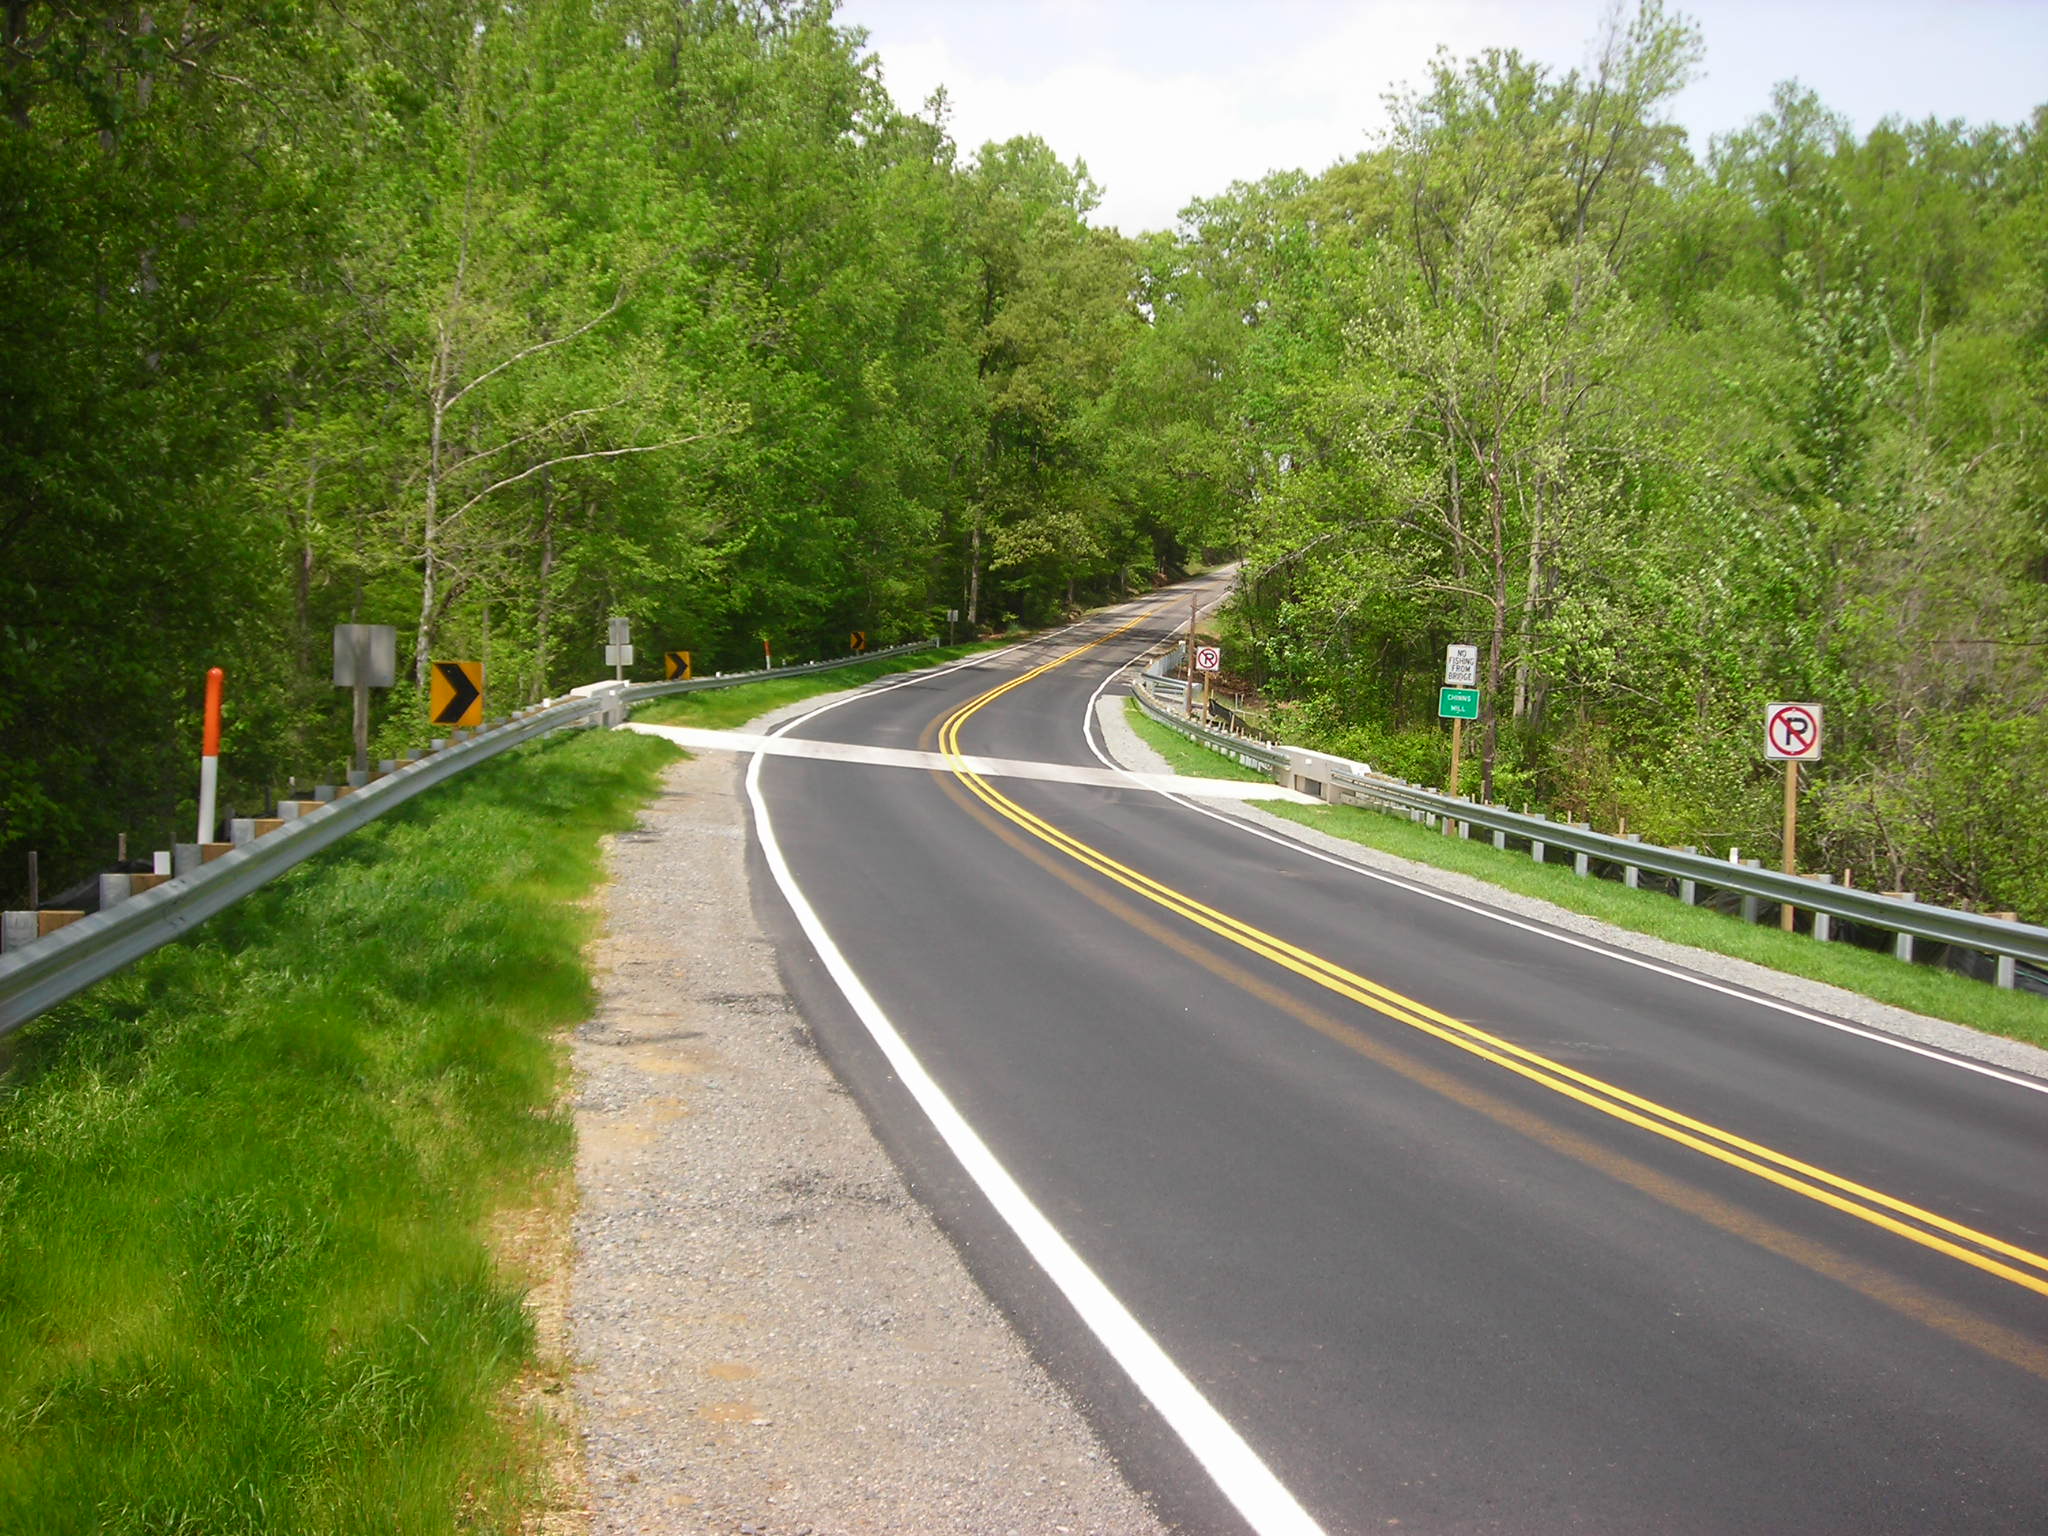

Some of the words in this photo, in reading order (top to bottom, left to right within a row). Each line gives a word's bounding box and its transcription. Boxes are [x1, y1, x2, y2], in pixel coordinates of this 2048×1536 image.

[1457, 649, 1467, 657] NO
[1204, 652, 1215, 665] P
[1448, 657, 1475, 665] FISHING
[1452, 664, 1471, 672] FROM
[1448, 672, 1472, 680] BRIDGE
[1786, 717, 1808, 746] P
